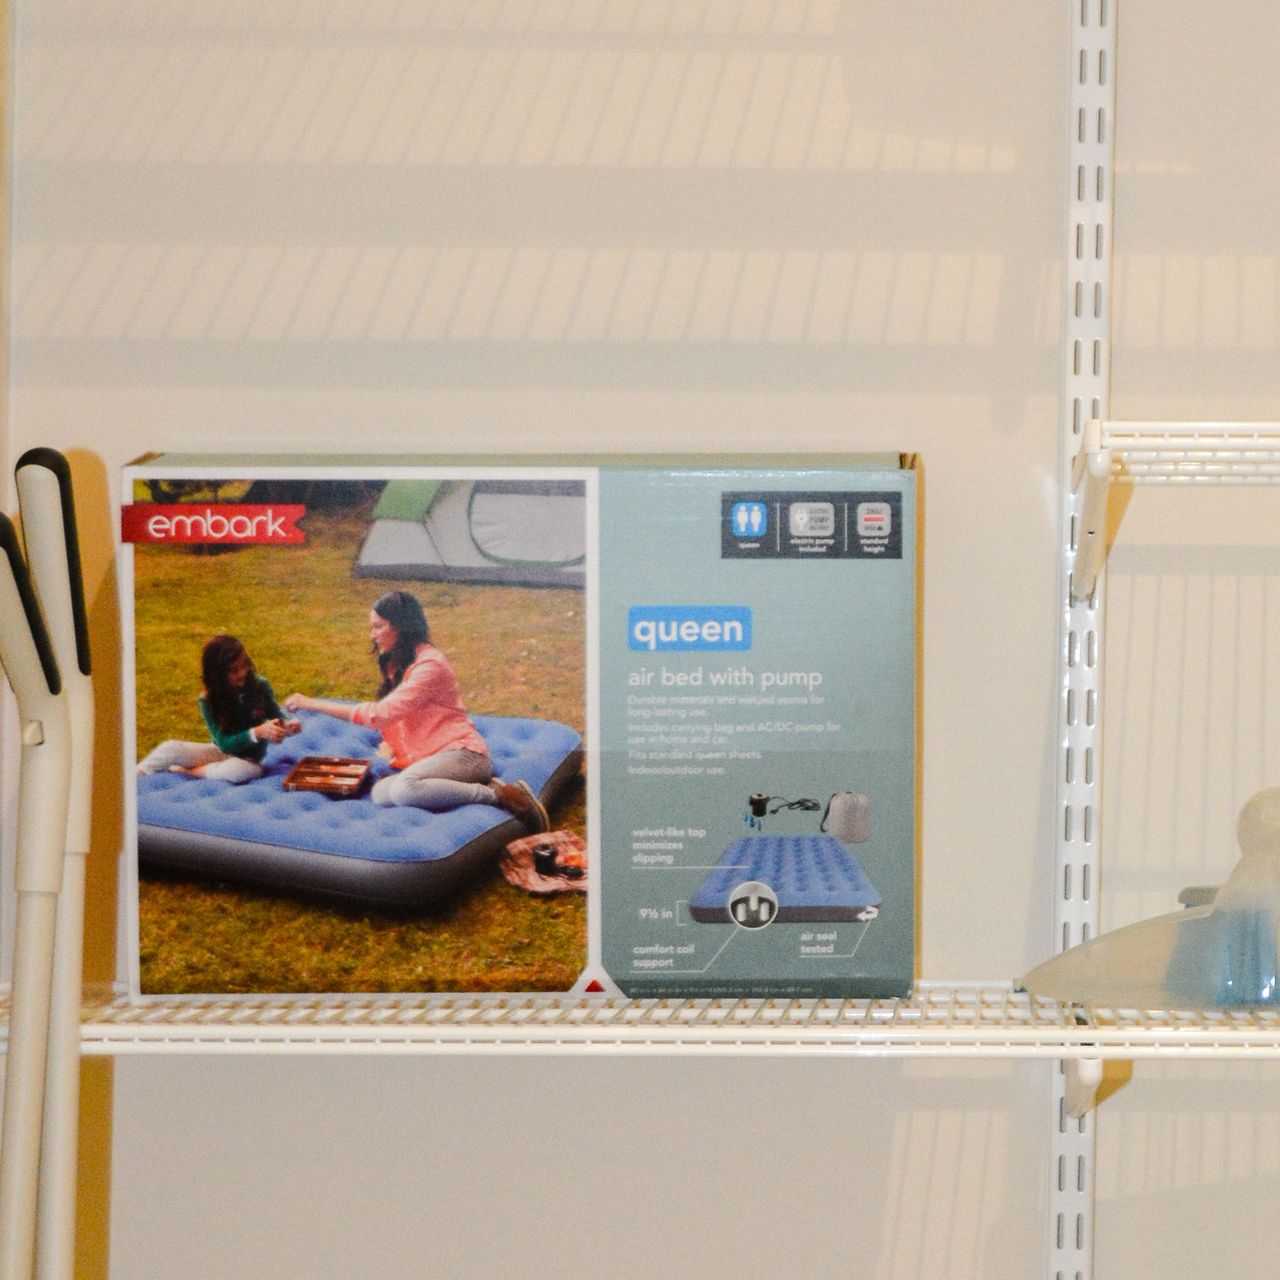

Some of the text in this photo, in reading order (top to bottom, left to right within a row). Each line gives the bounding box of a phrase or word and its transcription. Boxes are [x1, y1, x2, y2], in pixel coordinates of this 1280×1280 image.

[148, 508, 287, 539] embark
[634, 619, 744, 651] queen
[628, 665, 823, 692] air bed with pump
[716, 695, 736, 705] and
[810, 694, 825, 705] for
[713, 721, 734, 734] bag
[736, 722, 755, 732] and
[757, 722, 793, 733] AC/DC
[795, 724, 825, 734] pump
[826, 722, 841, 732] for
[659, 734, 688, 744] home
[648, 750, 693, 760] standard
[695, 751, 727, 761] queen
[627, 765, 705, 775] Indoor/outdoor
[632, 827, 707, 838] velvet-like top
[632, 840, 684, 850] minimizes
[631, 853, 674, 864] slipping
[661, 907, 673, 919] in
[800, 931, 837, 941] air seal
[633, 943, 695, 954] comfort coil
[800, 943, 834, 954] tested
[633, 957, 674, 968] support
